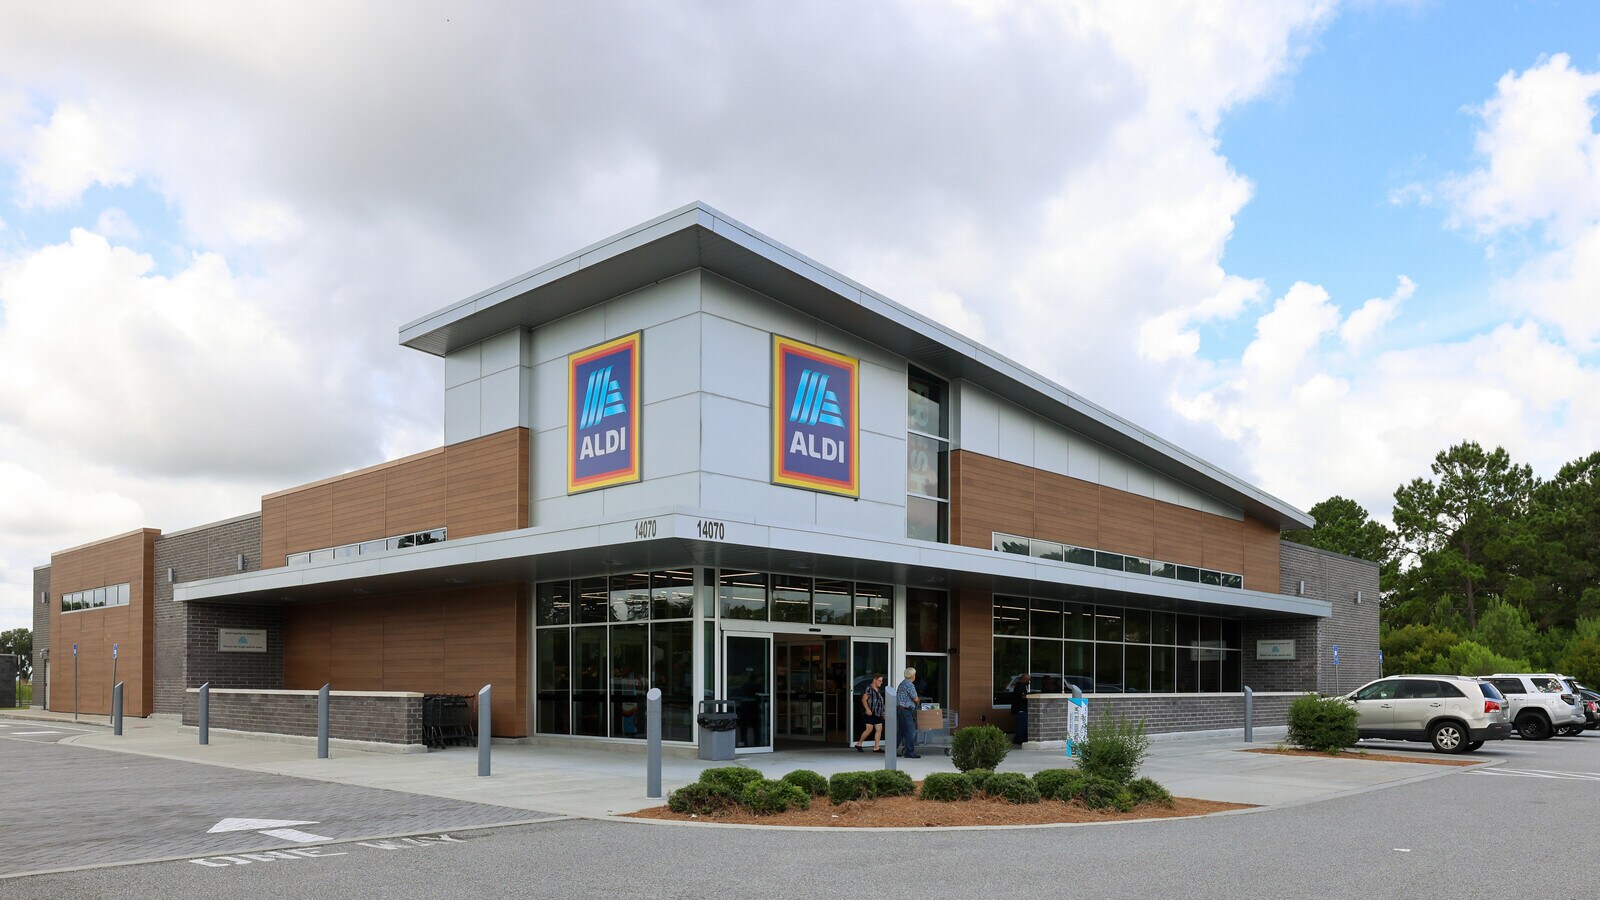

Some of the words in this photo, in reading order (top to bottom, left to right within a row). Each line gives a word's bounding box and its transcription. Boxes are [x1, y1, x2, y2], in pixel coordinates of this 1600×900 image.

[580, 427, 626, 460] ALDI
[790, 431, 844, 463] ALDI
[635, 520, 657, 539] 14070
[697, 520, 725, 540] 14070
